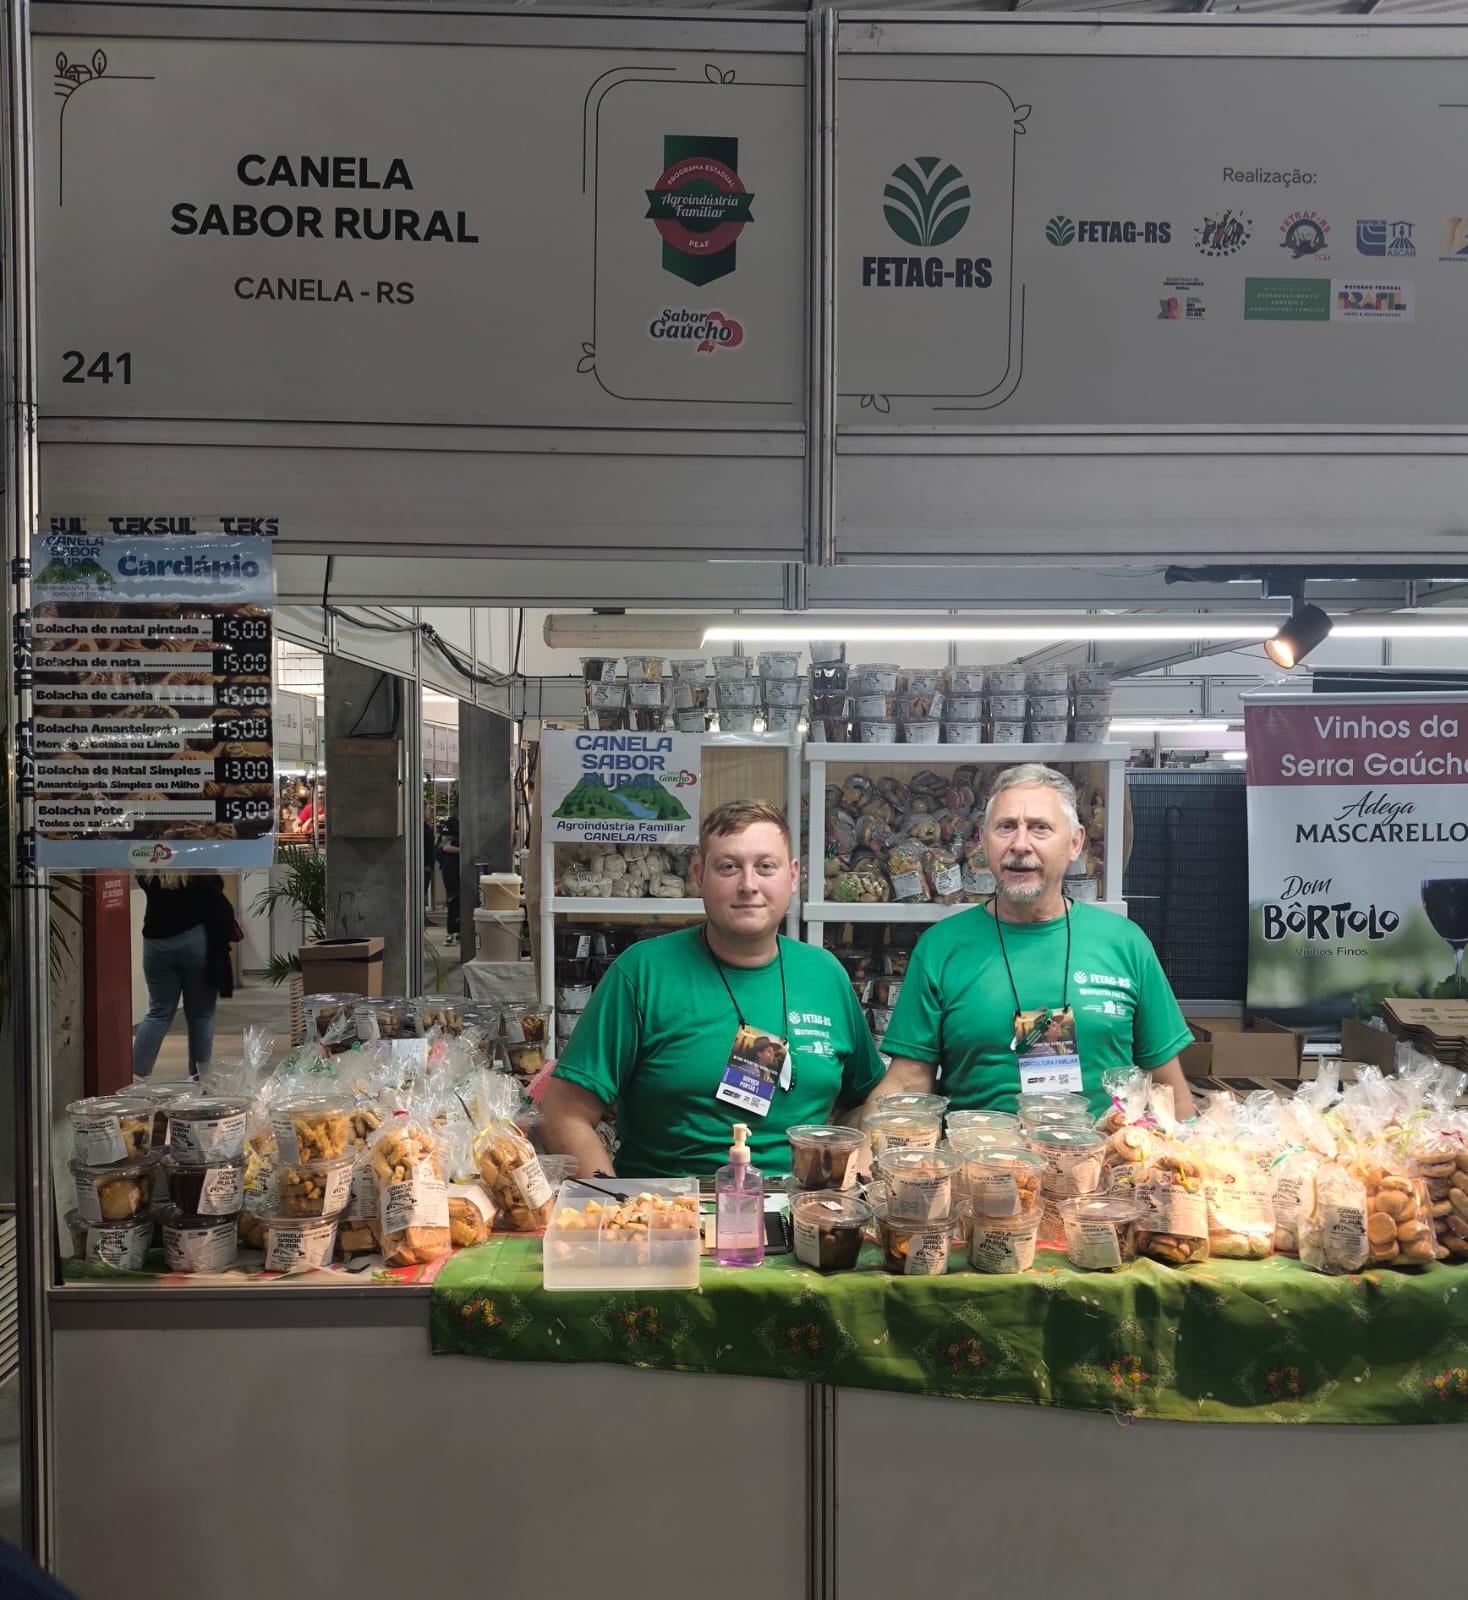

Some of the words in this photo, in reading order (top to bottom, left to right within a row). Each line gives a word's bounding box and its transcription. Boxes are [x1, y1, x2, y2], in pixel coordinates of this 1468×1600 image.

[236, 153, 414, 191] CANELA
[667, 164, 703, 185] PROGRAMA
[705, 164, 735, 187] ESTADUAL
[1222, 166, 1318, 187] Realização:
[661, 192, 739, 207] Agroindústria
[675, 204, 725, 218] Familiar
[170, 203, 323, 239] SABOR
[334, 205, 480, 244] RURAL
[1078, 220, 1171, 244] FETAG-RS
[688, 240, 710, 248] PEAF
[863, 256, 993, 289] FETAG-RS
[233, 276, 353, 303] CANELA
[376, 281, 415, 304] RS
[661, 308, 707, 323] Sabor
[649, 319, 732, 341] Gaúcho
[62, 350, 134, 385] 241
[108, 516, 197, 535] TEKSUL
[46, 535, 104, 546] CANELA
[50, 547, 100, 556] SABOR
[117, 555, 260, 584] Cardápio
[35, 623, 88, 634] Bolacha
[91, 624, 107, 634] de
[110, 624, 145, 634] natal
[147, 624, 199, 637] pintada
[35, 657, 88, 667] Bolacha
[91, 657, 107, 667] de
[110, 658, 140, 667] nata
[36, 690, 89, 700] Bolacha
[91, 690, 107, 700] de
[110, 691, 153, 700] canela
[36, 723, 88, 734] Bolacha
[1314, 715, 1411, 739] Vinhos
[1419, 714, 1459, 738] da
[146, 739, 181, 749] Limão
[575, 735, 673, 753] CANELA
[582, 754, 666, 771] SABOR
[1281, 753, 1354, 777] Serra
[37, 765, 90, 775] Bolacha
[92, 765, 109, 775] de
[111, 766, 147, 775] Natal
[149, 765, 201, 777] Simples
[36, 781, 108, 790] Amanteigada
[110, 781, 152, 791] Simples
[170, 780, 200, 789] Milho
[38, 806, 91, 815] Bolacha
[93, 806, 124, 816] Pote
[1333, 790, 1417, 826] Adega
[37, 820, 70, 828] Todos
[556, 820, 635, 832] Agroindústria
[638, 821, 686, 833] Familiar
[584, 832, 658, 843] CANELA/RS
[1295, 822, 1468, 843] MASCARELLO
[1280, 875, 1332, 900] Dom
[1295, 947, 1333, 957] Vinhos
[1337, 946, 1369, 957] Finos
